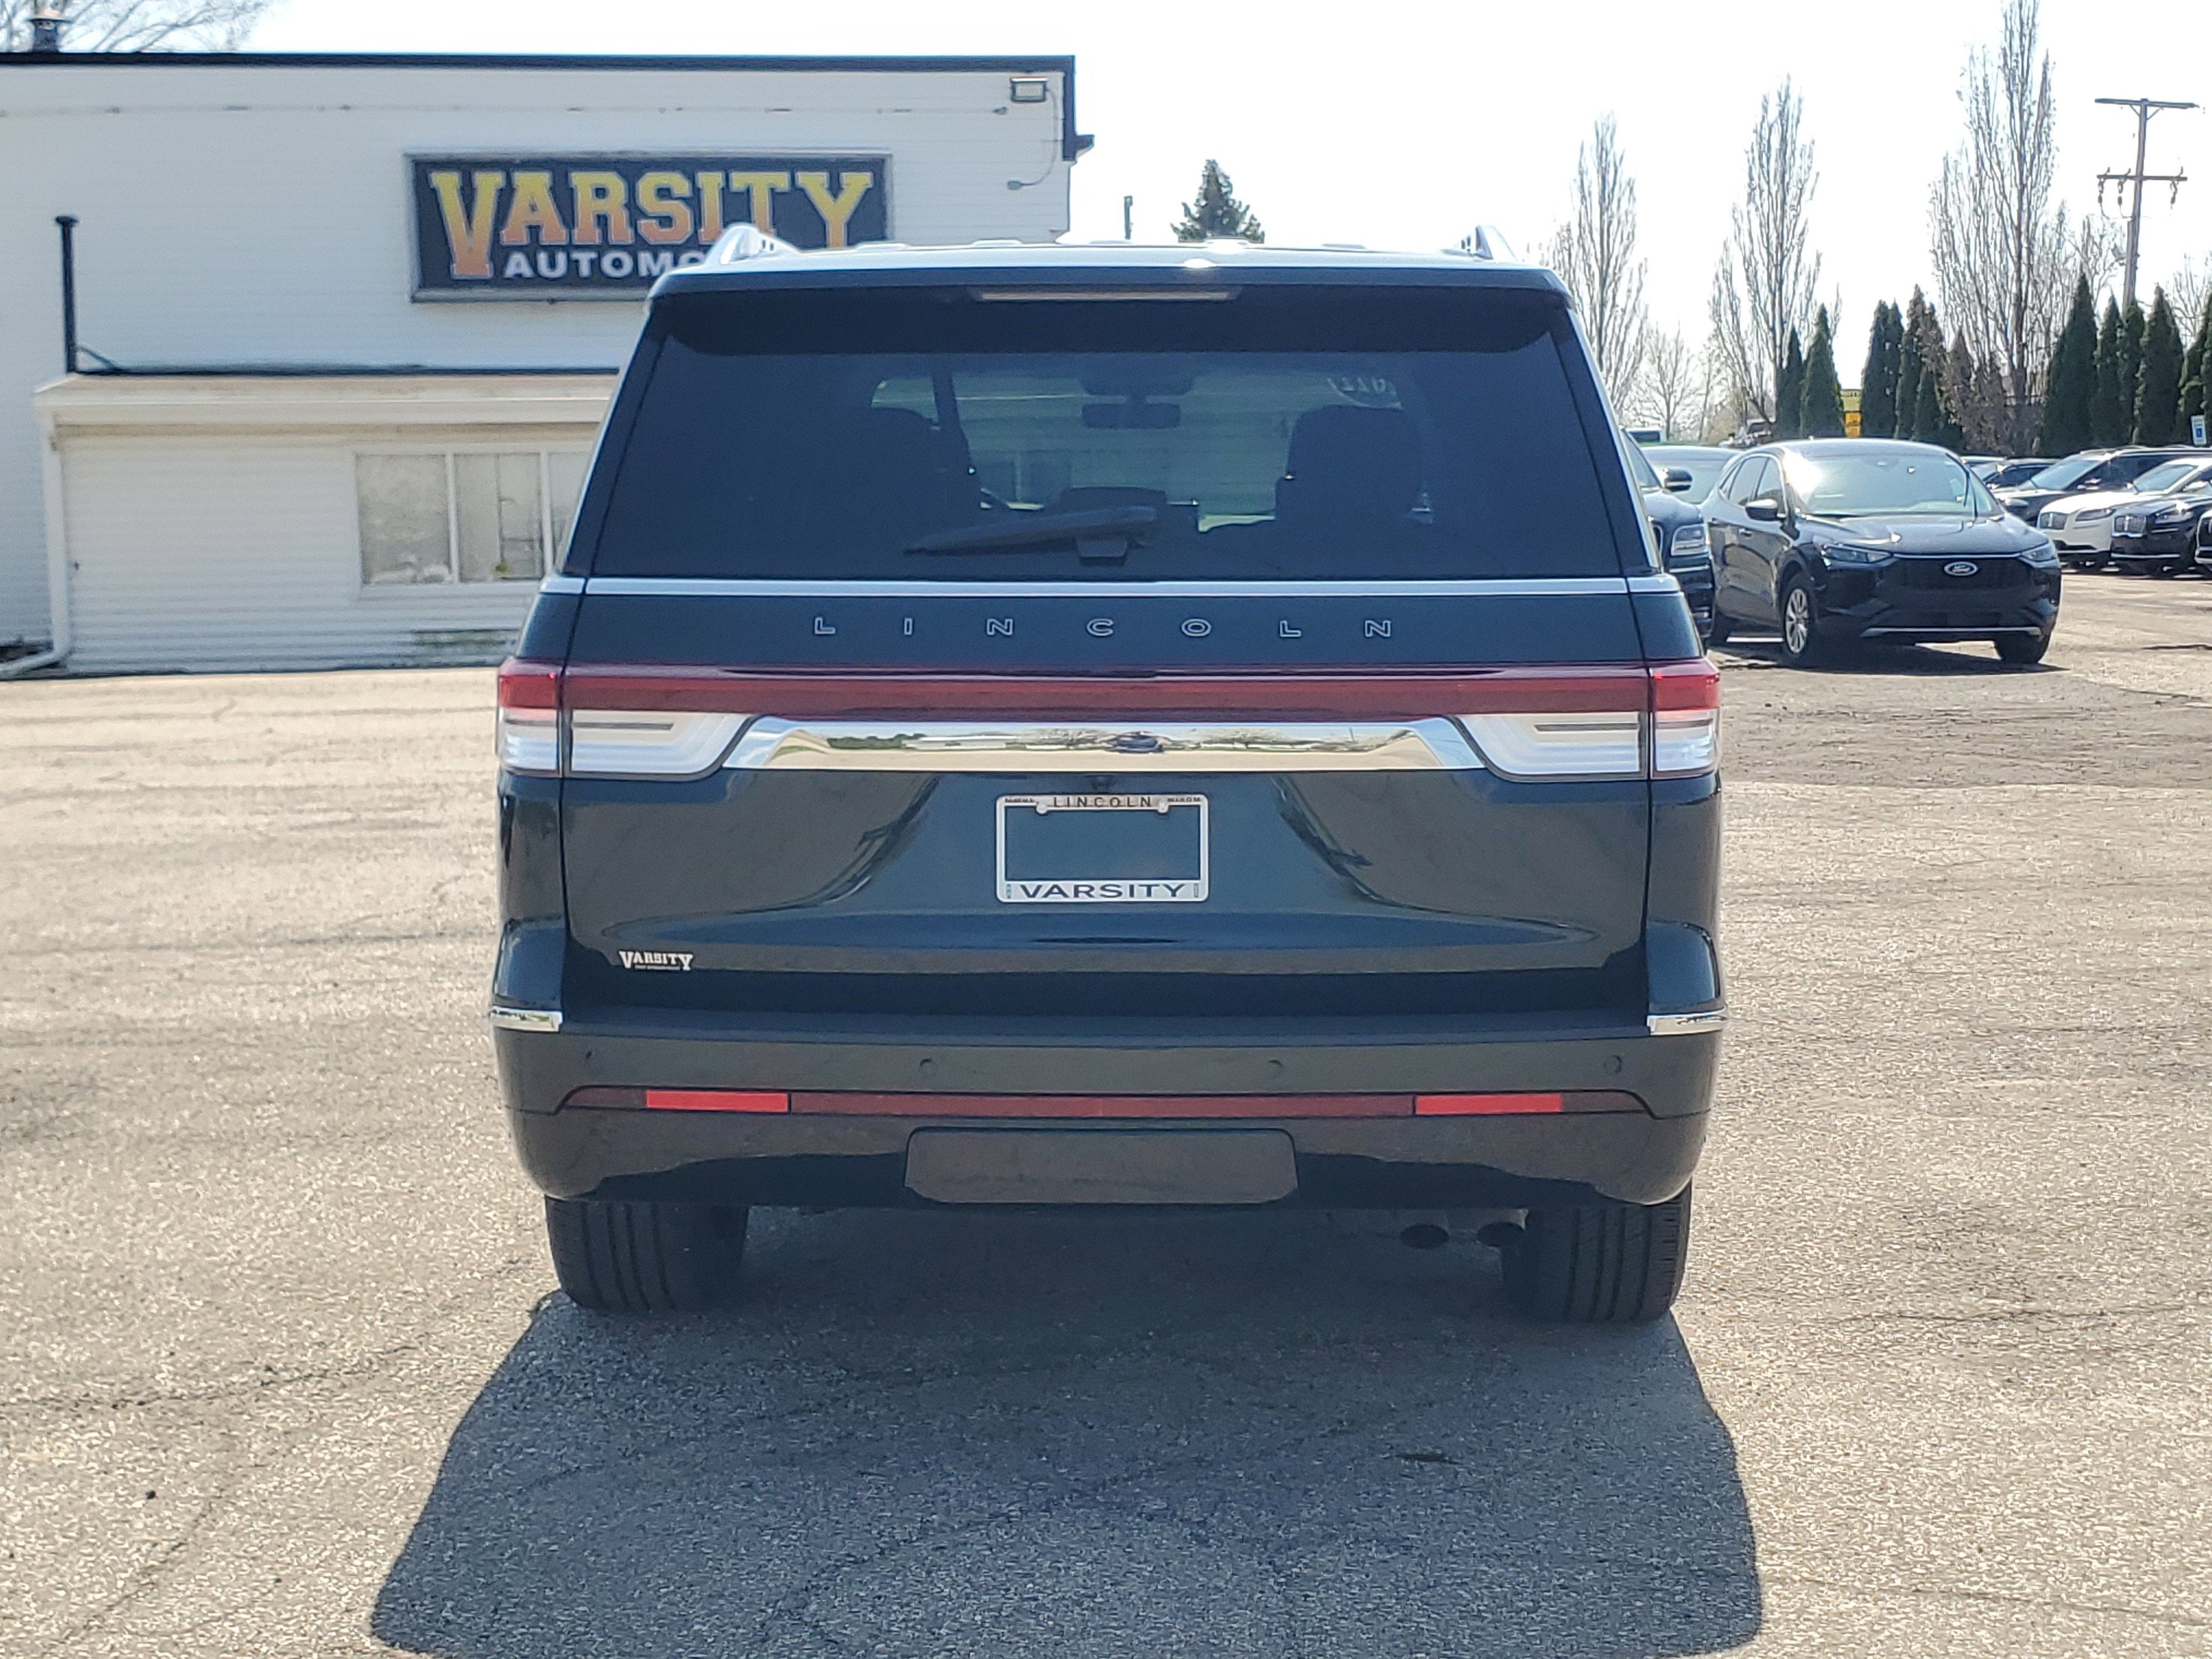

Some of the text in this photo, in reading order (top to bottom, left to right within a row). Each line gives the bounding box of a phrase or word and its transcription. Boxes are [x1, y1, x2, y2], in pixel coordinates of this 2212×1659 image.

[430, 171, 873, 279] VARSITY
[814, 616, 1392, 640] LINCOLN
[1053, 796, 1151, 808] LINCOLN
[1019, 884, 1186, 899] VARSITY
[618, 950, 693, 971] VARSITY
